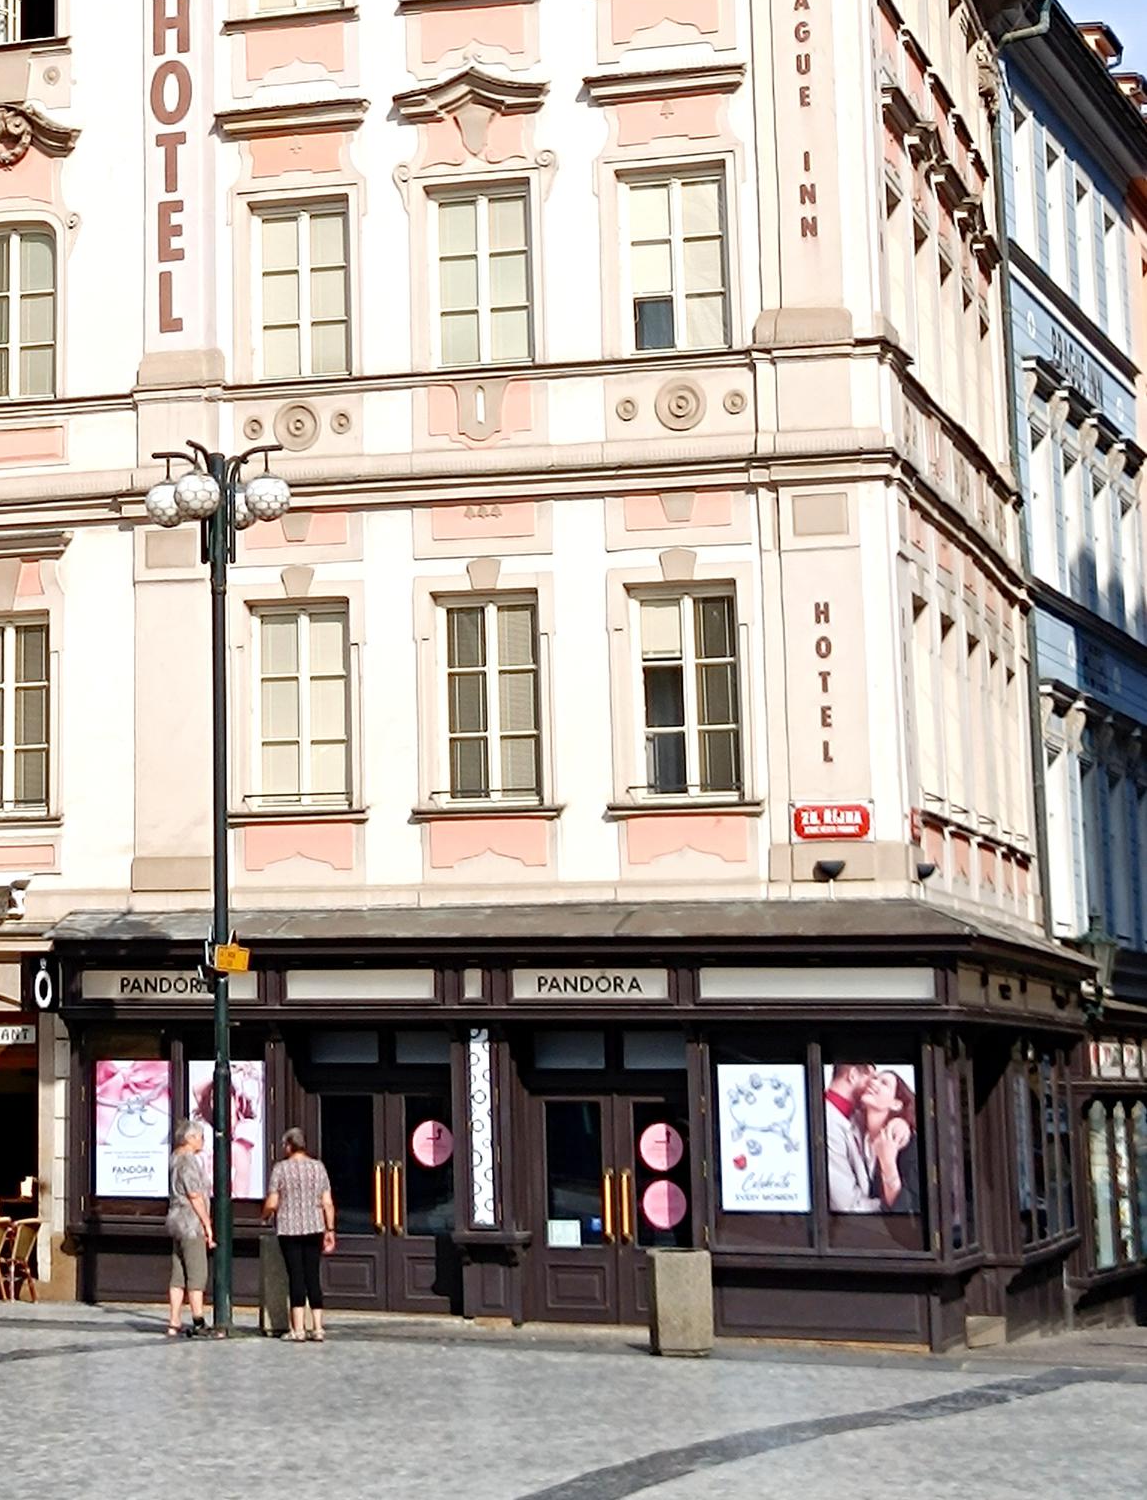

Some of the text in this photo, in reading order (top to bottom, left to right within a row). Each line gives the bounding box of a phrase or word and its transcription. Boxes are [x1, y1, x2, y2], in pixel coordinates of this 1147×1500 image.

[799, 150, 818, 237] INN
[814, 601, 834, 762] HOTEL
[537, 975, 643, 993] PANDORA
